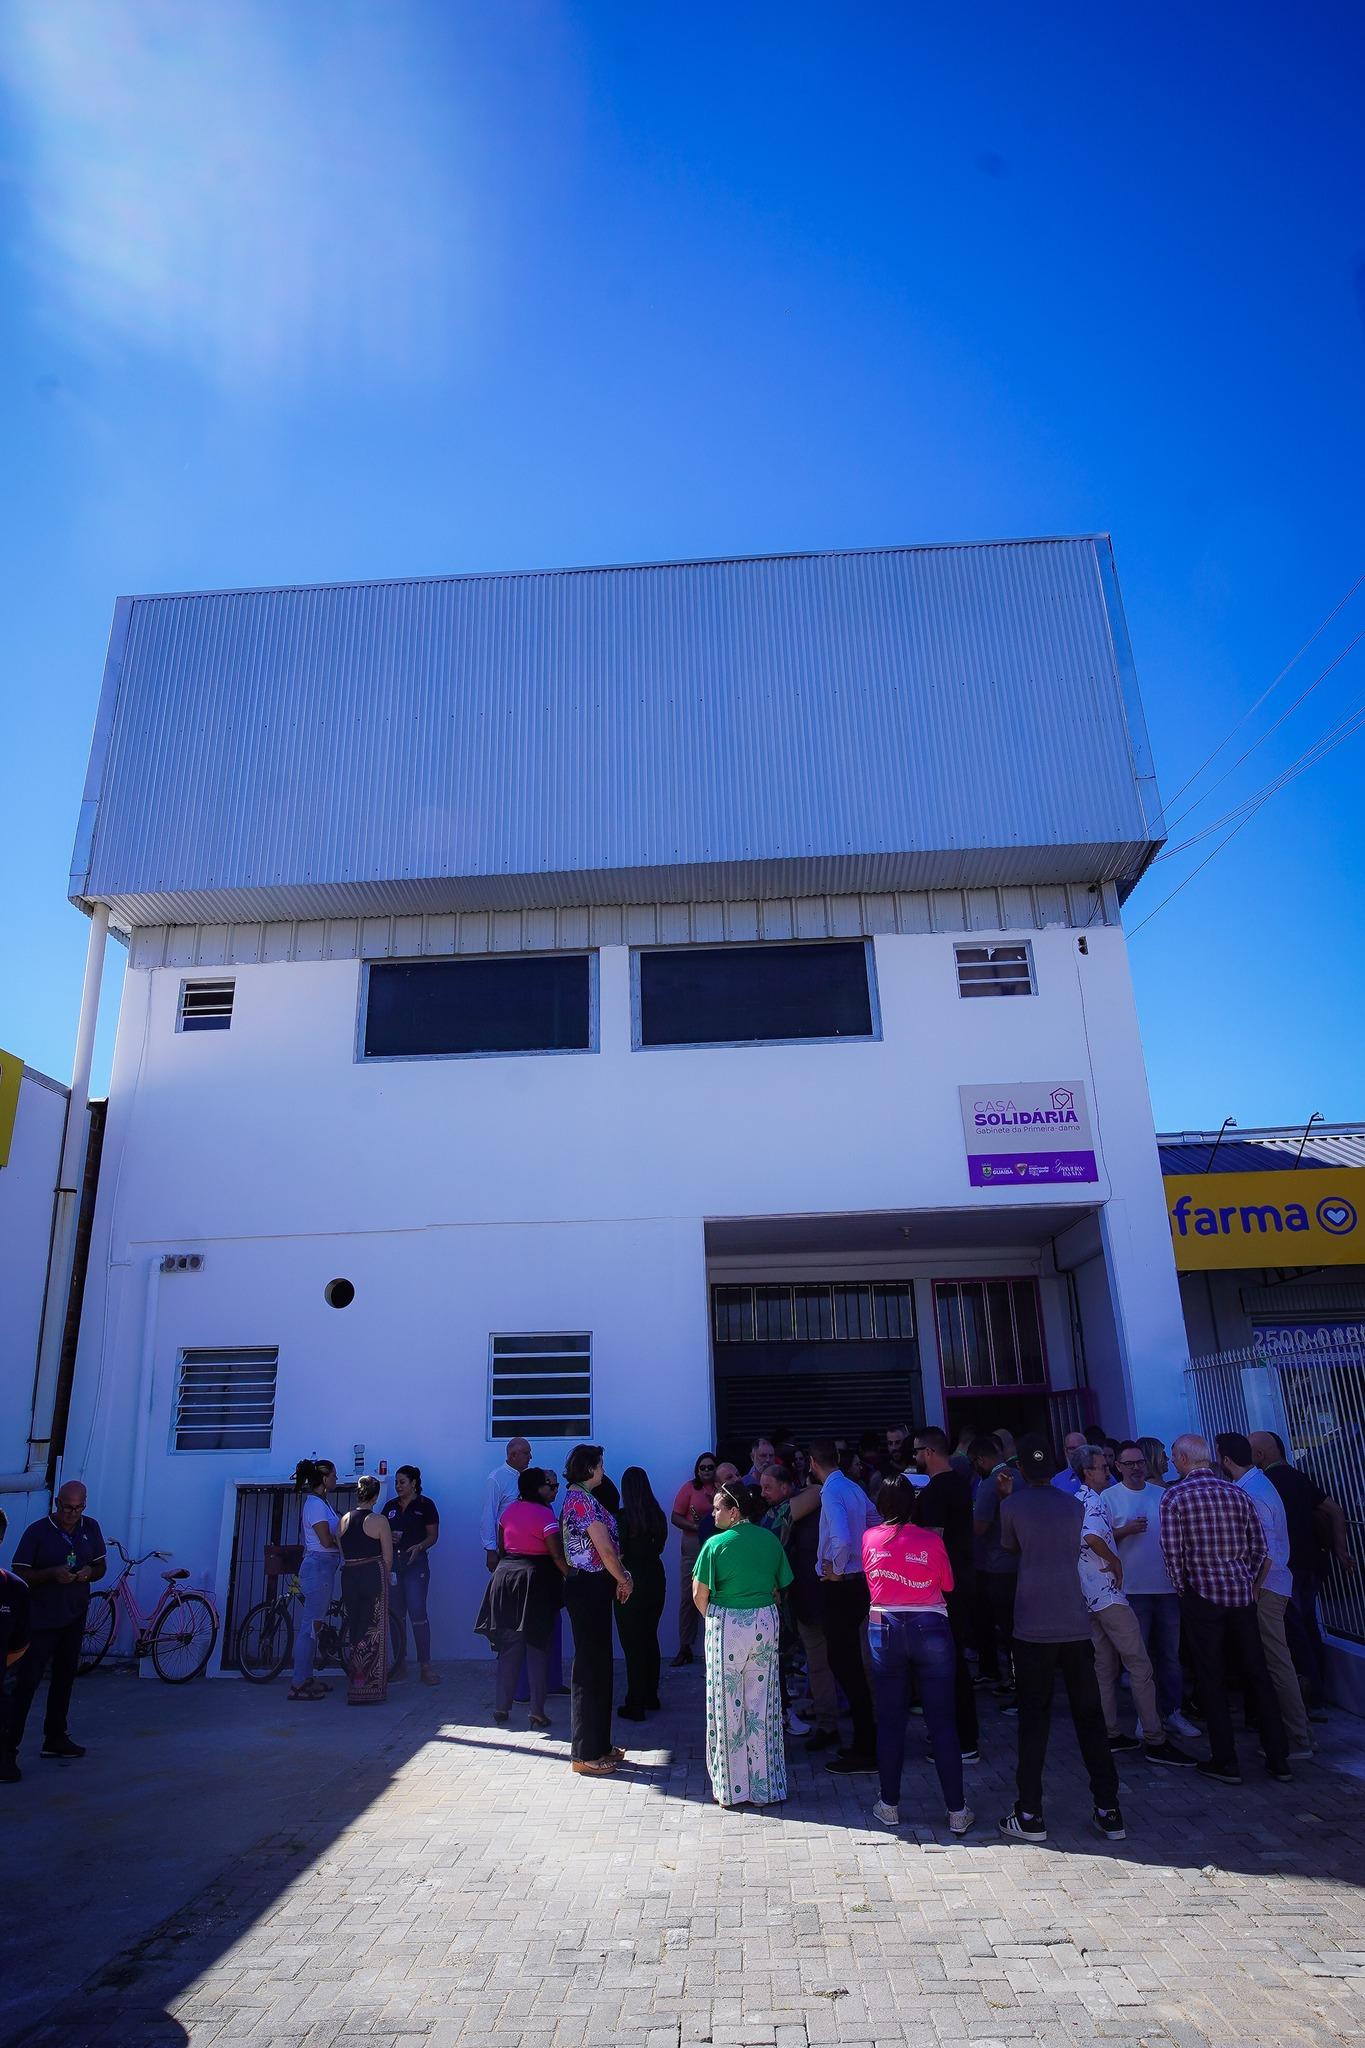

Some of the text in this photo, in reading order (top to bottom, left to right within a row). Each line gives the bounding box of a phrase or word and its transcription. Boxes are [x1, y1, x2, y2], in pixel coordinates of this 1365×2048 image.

[974, 1100, 1017, 1113] CASA
[974, 1108, 1079, 1126] SOLIDÁRIA
[976, 1126, 1010, 1135] Gabinete
[1011, 1125, 1022, 1133] da
[1169, 1195, 1310, 1236] farma
